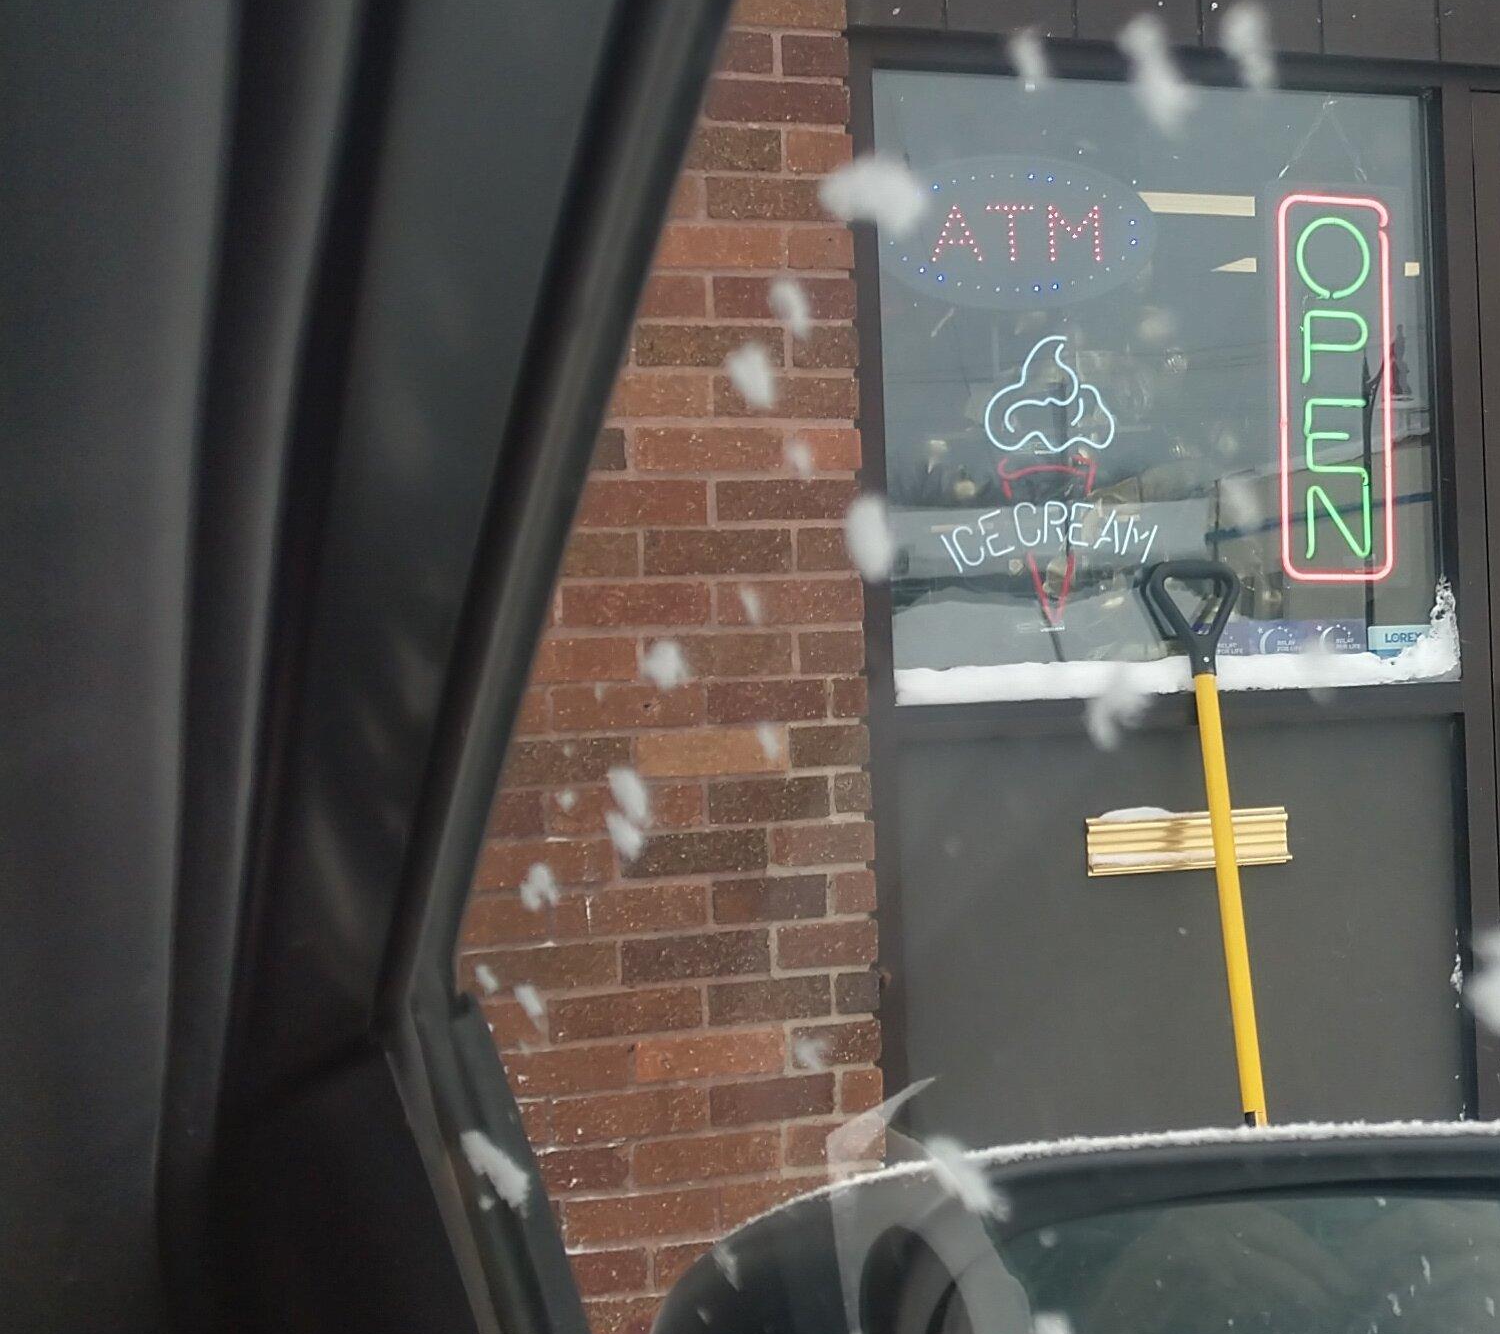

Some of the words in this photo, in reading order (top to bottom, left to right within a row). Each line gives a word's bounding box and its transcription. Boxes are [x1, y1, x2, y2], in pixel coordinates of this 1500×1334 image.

[931, 203, 1103, 262] ATM
[1296, 216, 1371, 560] OPEN
[940, 509, 1016, 574] ICE
[1013, 500, 1159, 564] CREAM
[1384, 631, 1423, 644] LOREX
